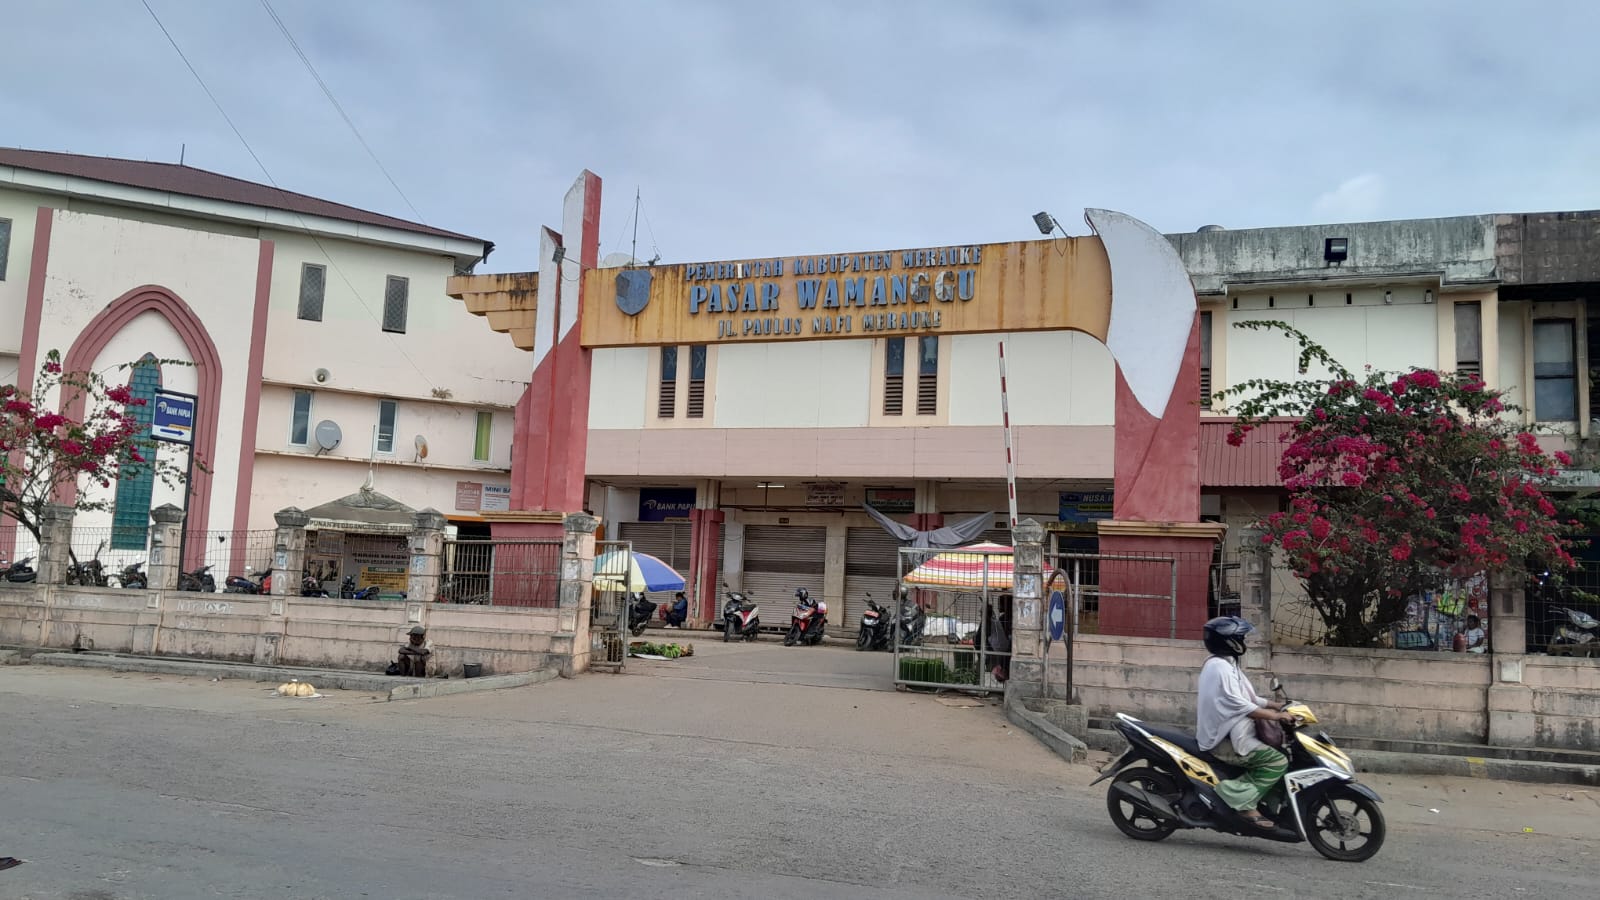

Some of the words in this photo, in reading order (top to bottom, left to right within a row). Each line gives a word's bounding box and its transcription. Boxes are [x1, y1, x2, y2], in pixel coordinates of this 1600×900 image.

[686, 260, 784, 281] PEMERINTAH
[794, 253, 892, 275] KABUPATEN
[902, 247, 982, 269] MERAUKE
[690, 281, 780, 314] PASAR
[796, 269, 976, 308] WAMANGGU
[718, 320, 738, 339] JL.
[743, 316, 802, 336] PAULUS
[812, 314, 852, 333] NAFI
[863, 309, 942, 331] MERAUKE
[656, 503, 676, 511] BANK
[1082, 494, 1105, 502] NUSA
